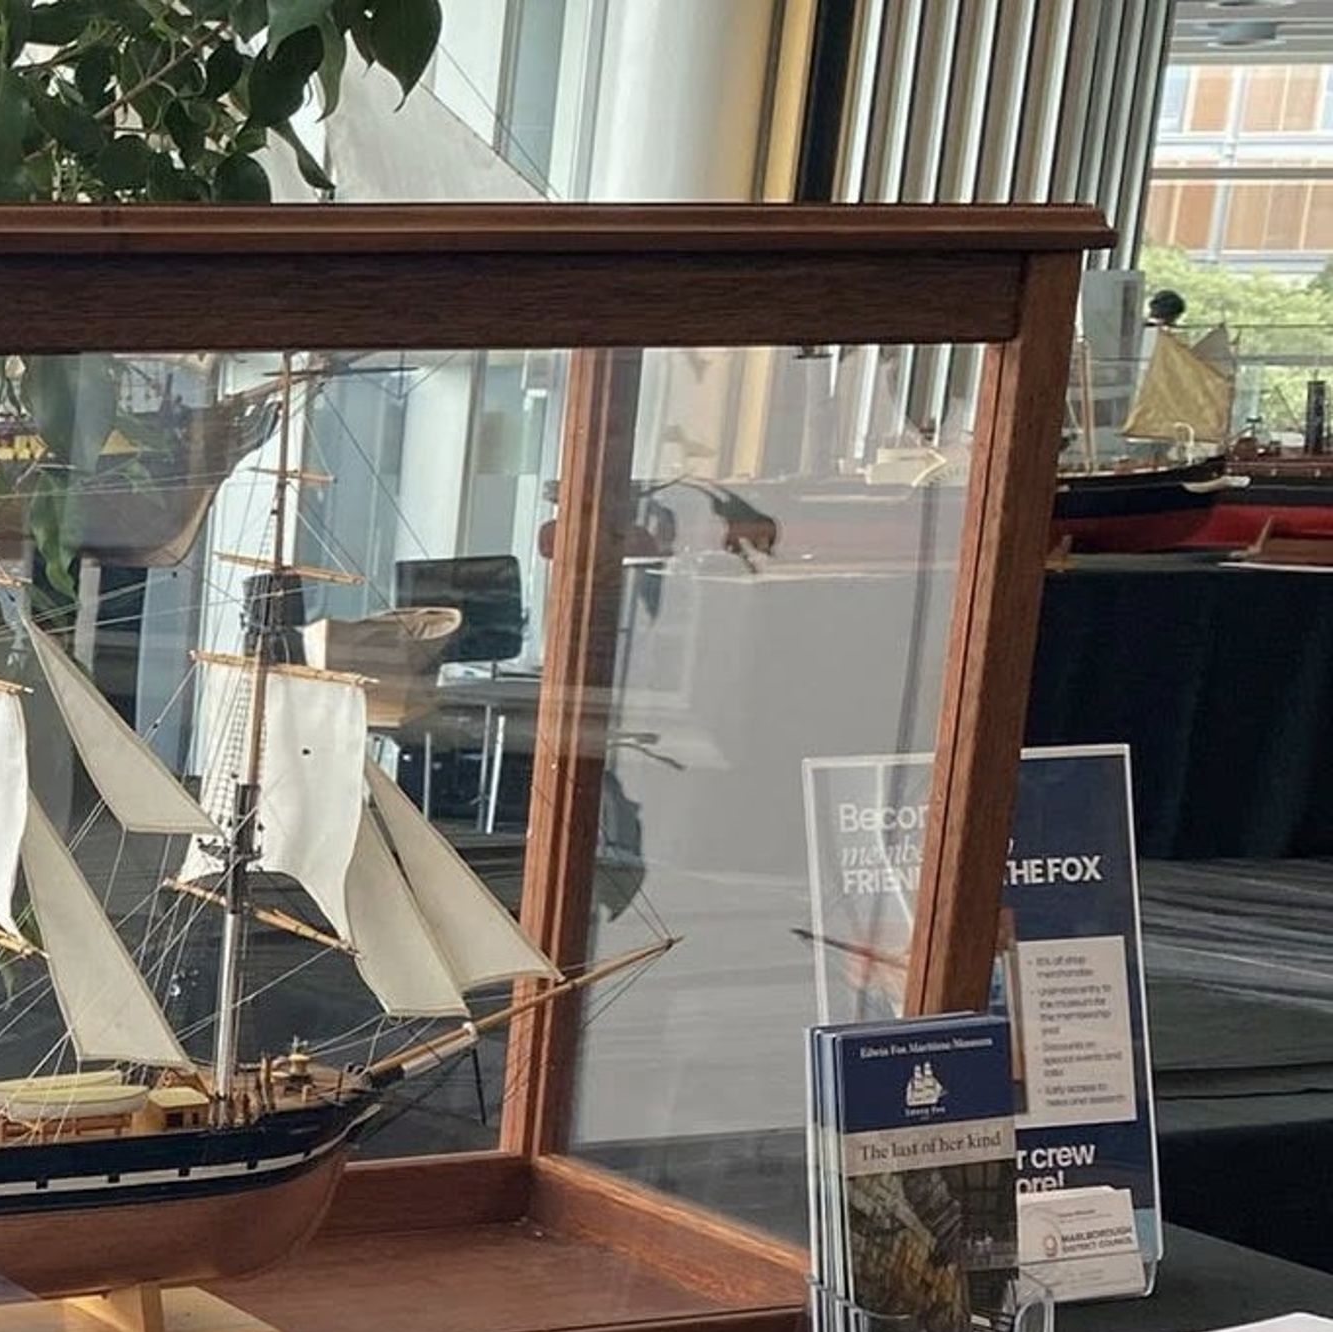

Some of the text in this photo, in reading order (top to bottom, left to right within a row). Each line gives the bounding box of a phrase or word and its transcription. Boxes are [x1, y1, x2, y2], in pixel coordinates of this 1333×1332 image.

[843, 866, 921, 894] FRIEN
[1047, 854, 1102, 882] FOX
[862, 1130, 1002, 1161] The last of her kind
[1030, 1143, 1096, 1170] crew
